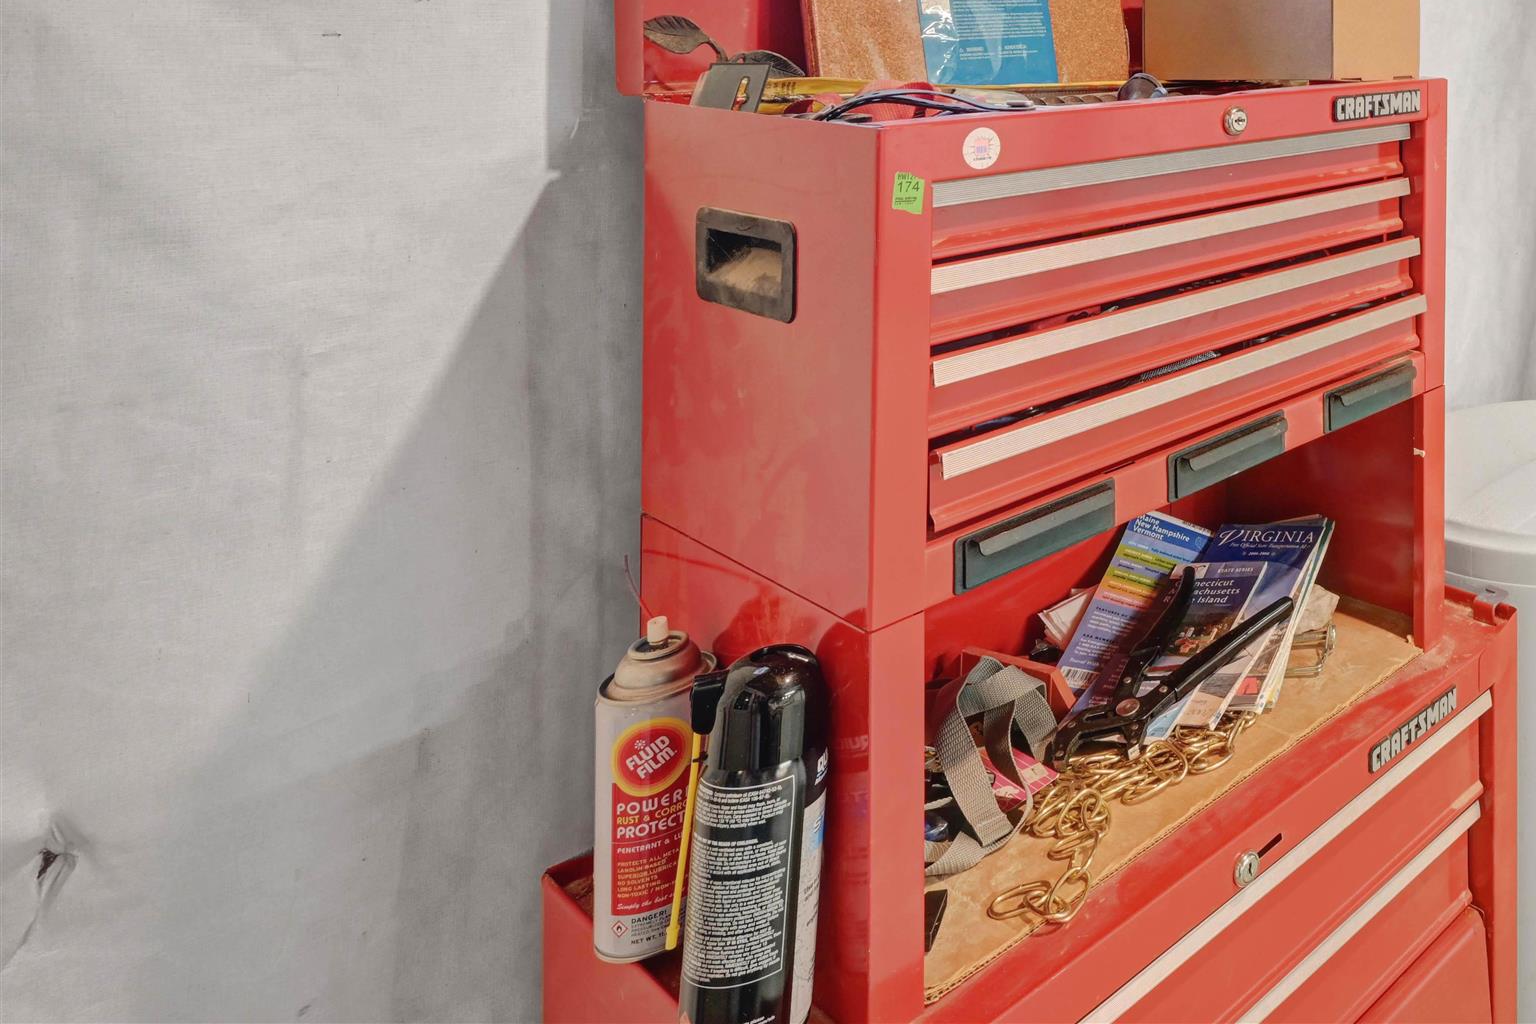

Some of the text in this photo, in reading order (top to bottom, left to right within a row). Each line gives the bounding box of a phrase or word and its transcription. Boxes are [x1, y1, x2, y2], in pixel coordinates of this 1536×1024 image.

[1336, 90, 1421, 121] CRAFTSMAN
[897, 181, 920, 193] 174
[1132, 525, 1165, 541] Vermont
[1135, 519, 1152, 530] New
[1153, 522, 1191, 543] Hampshire
[1218, 528, 1314, 547] VIRGINIA
[1197, 595, 1228, 603] Island
[1371, 686, 1457, 773] CRAFTSMAN
[625, 735, 671, 771] FLUID
[636, 746, 676, 779] FILM
[617, 815, 639, 825] RUST
[617, 840, 661, 854] PENETRANT
[627, 874, 658, 885] SOLVENTS
[631, 909, 668, 924] DANGER!
